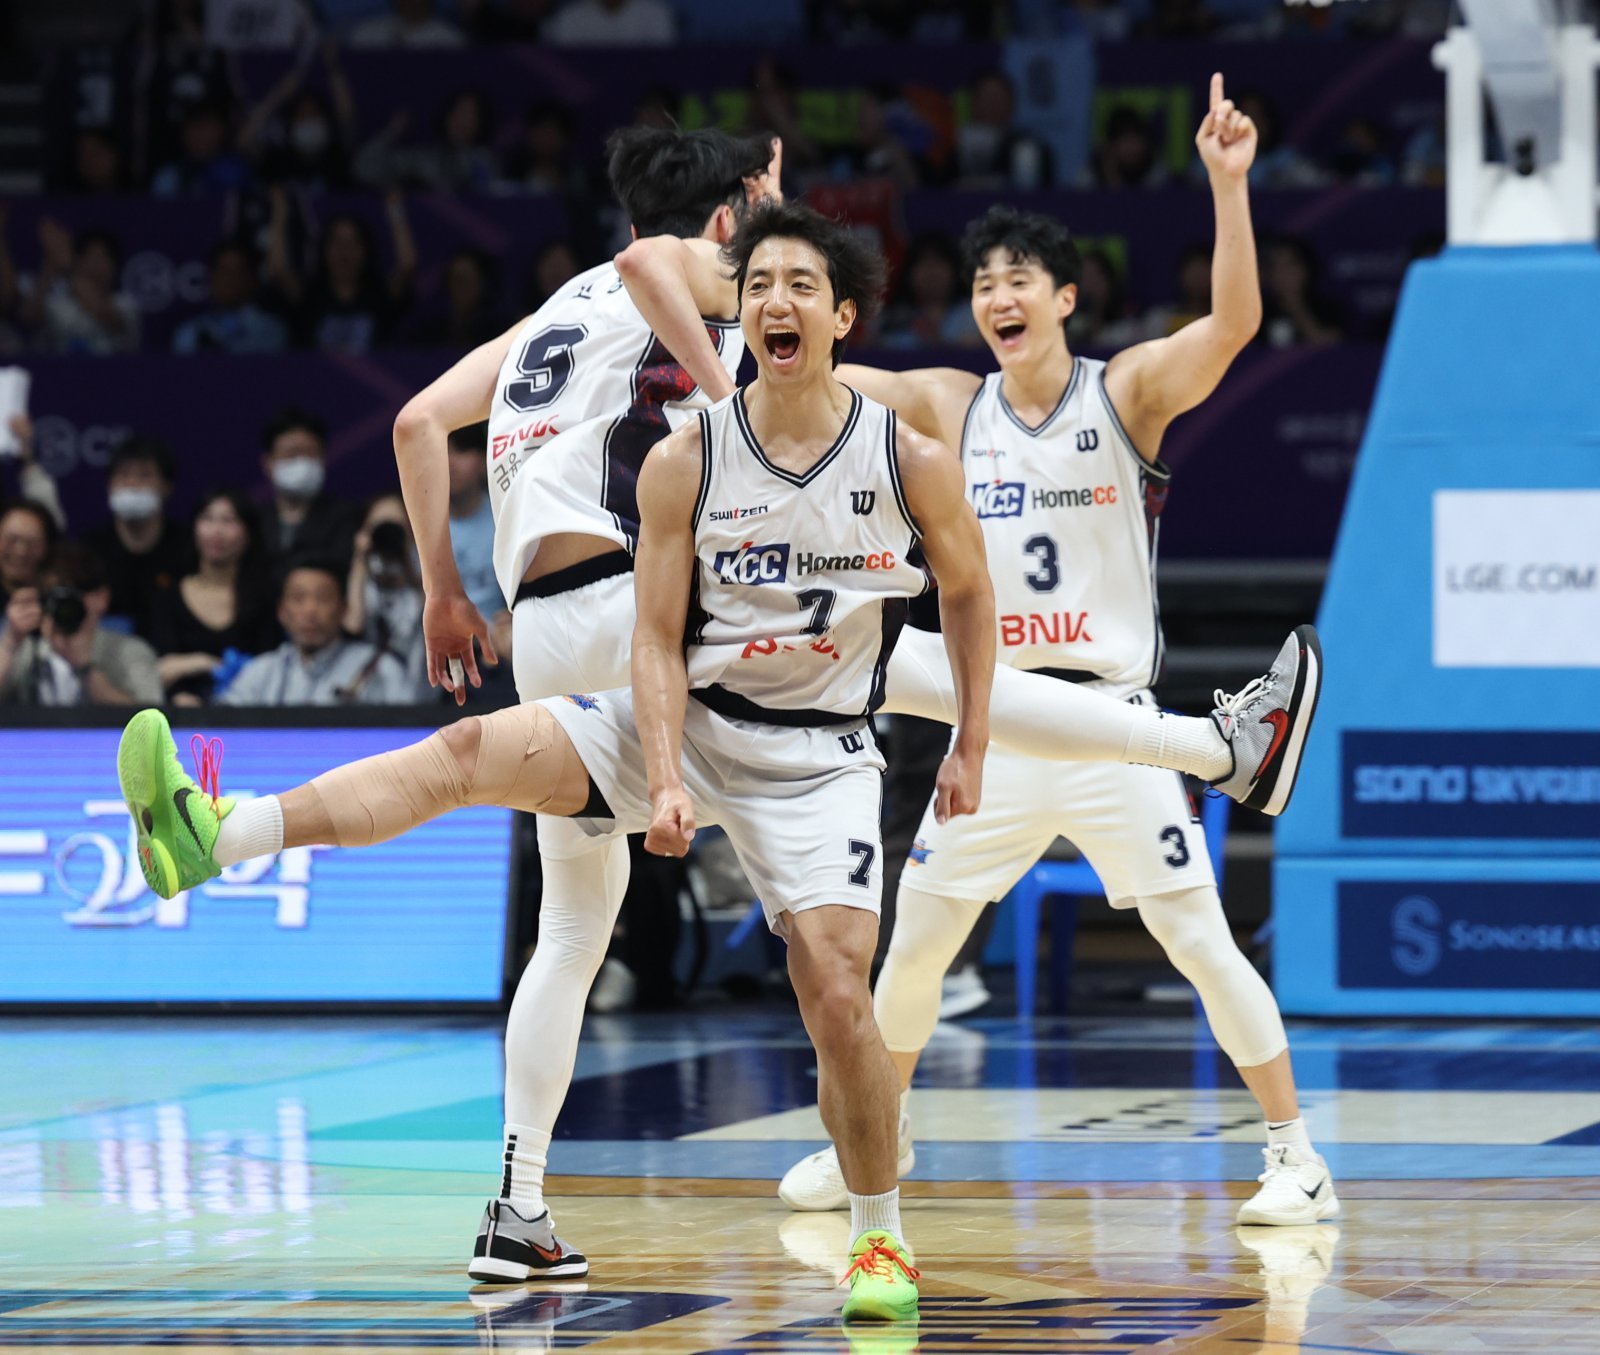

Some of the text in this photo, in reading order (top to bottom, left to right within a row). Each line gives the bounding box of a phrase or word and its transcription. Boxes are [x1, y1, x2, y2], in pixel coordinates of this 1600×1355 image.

[504, 323, 589, 413] 9
[973, 480, 1117, 518] KCC Homecc
[716, 544, 896, 585] KCC Homecc
[1022, 533, 1061, 594] 3
[1446, 563, 1597, 593] LGE.COM
[797, 588, 836, 637] 7
[1001, 612, 1092, 646] BNK
[848, 838, 875, 888] 7
[1159, 824, 1191, 869] 3
